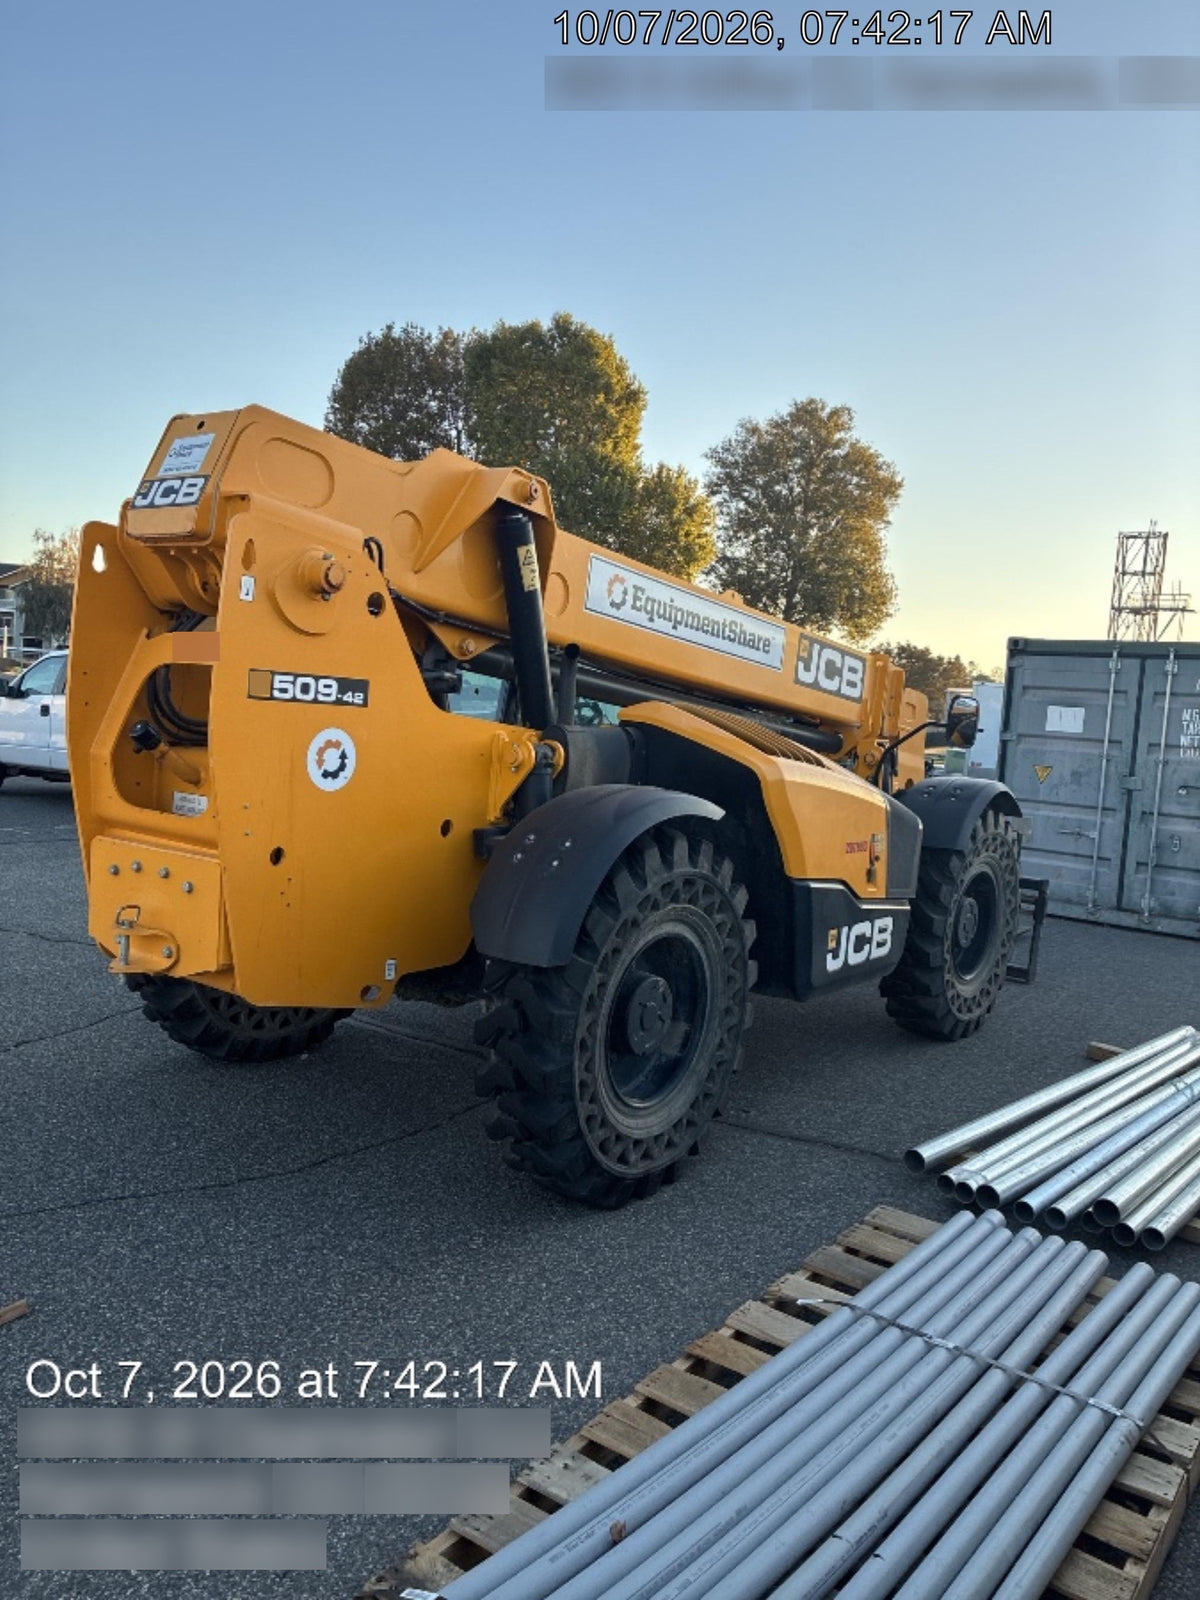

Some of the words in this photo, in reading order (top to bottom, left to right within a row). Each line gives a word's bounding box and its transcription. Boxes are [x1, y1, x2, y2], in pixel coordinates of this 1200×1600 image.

[134, 477, 206, 507] JCB
[630, 584, 771, 654] EquipmentShare
[797, 643, 864, 698] JCB
[825, 916, 893, 973] JCB
